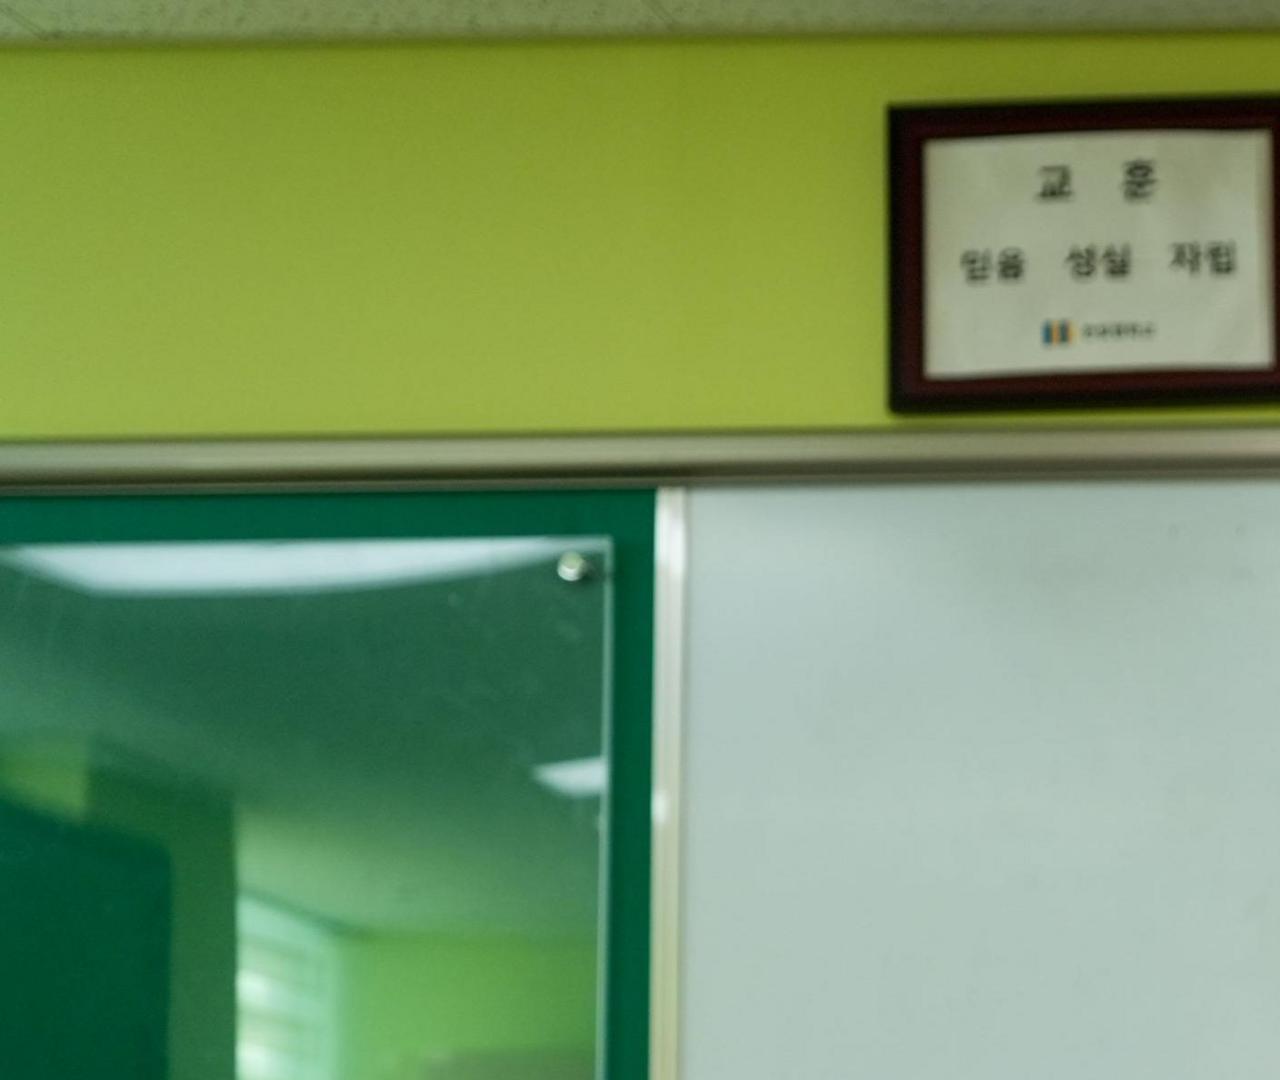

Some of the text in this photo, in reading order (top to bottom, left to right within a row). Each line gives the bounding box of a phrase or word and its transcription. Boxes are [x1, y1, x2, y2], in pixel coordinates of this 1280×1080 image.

[1035, 159, 1159, 202] 교 훈
[1065, 243, 1132, 281] 성실
[1169, 240, 1238, 277] 자립
